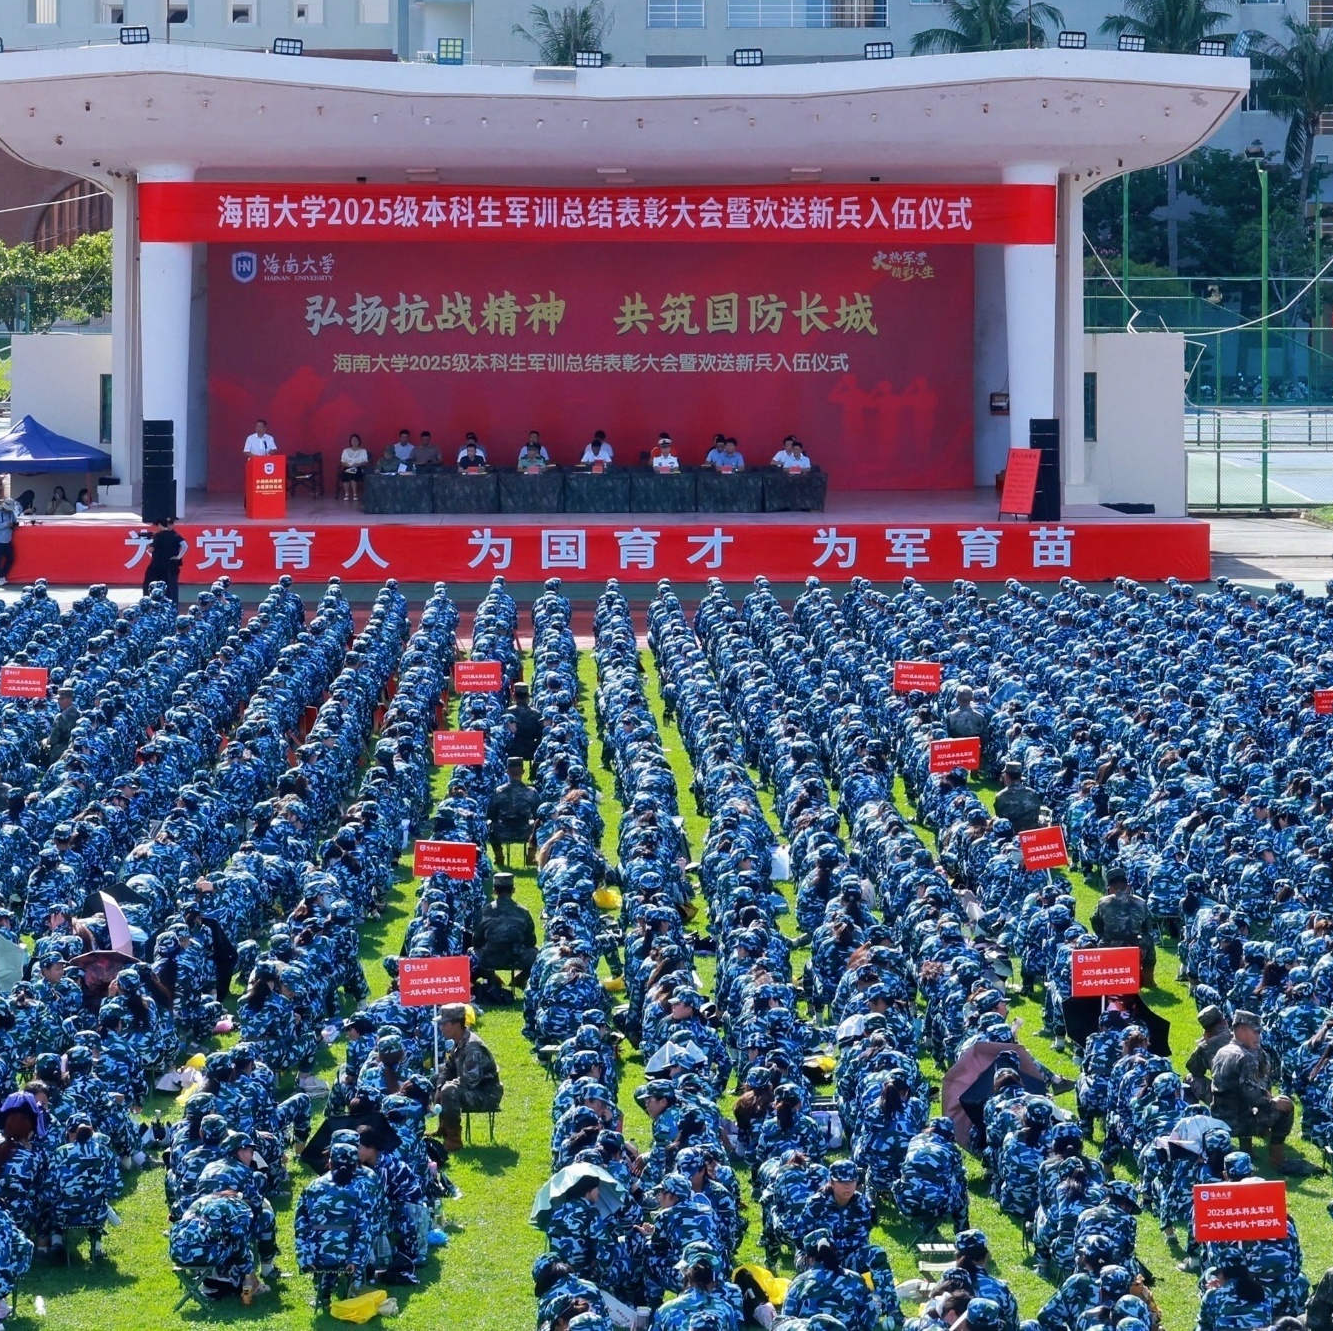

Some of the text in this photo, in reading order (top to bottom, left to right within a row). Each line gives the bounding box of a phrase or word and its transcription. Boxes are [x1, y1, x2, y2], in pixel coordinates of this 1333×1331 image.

[217, 194, 973, 230] 海南大学2025级本科生军训总结表彰大会暨欢送新兵入伍仪式
[263, 253, 335, 275] 海南大学
[871, 251, 927, 270] 火热军营
[305, 291, 879, 336] 弘扬抗战精神 共筑国防长城
[333, 353, 849, 373] 海南大学2025级本科生军训总结表彰大会暨欢送新兵入伍仪式
[468, 528, 734, 569] 为国育才
[813, 527, 1076, 569] 为军育苗
[410, 976, 460, 985] 2025级本科生军训
[1082, 967, 1130, 976] 2025级本科生军训
[405, 986, 465, 996] 一大队七中队三十四分队
[1207, 1206, 1274, 1217] 2025级本科生军训
[1201, 1219, 1281, 1230] 一大队七中队十四分队
